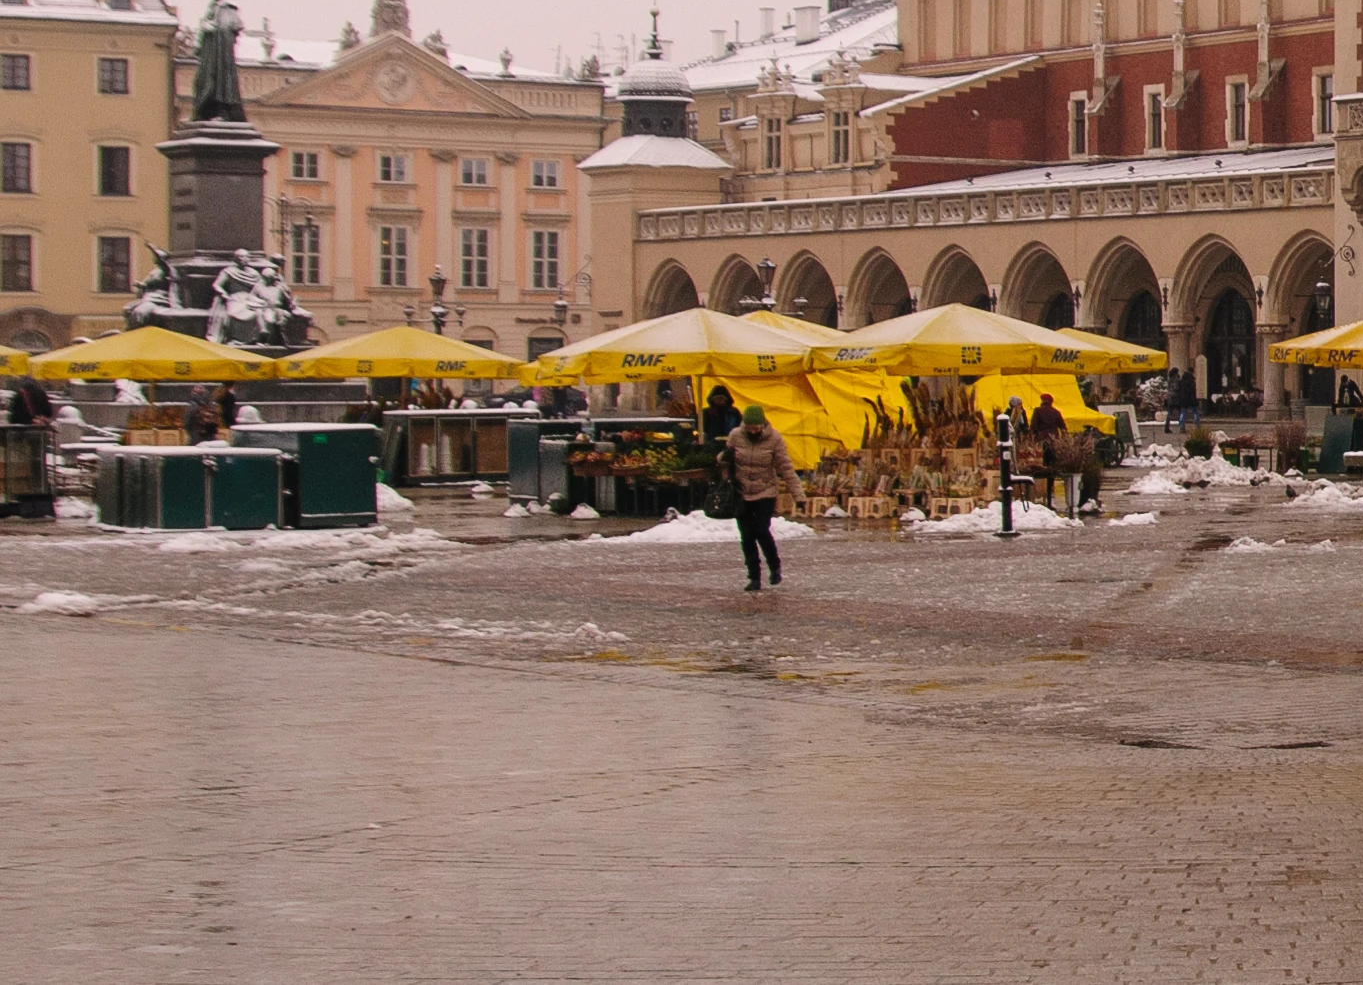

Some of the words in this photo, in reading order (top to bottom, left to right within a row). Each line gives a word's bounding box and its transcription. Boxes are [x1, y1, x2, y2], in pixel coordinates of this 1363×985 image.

[621, 354, 666, 368] RMF
[834, 347, 873, 362] RMF
[1051, 348, 1081, 363] RMF
[1328, 349, 1360, 362] RMF
[68, 362, 100, 373] RMF
[436, 361, 467, 372] RMF
